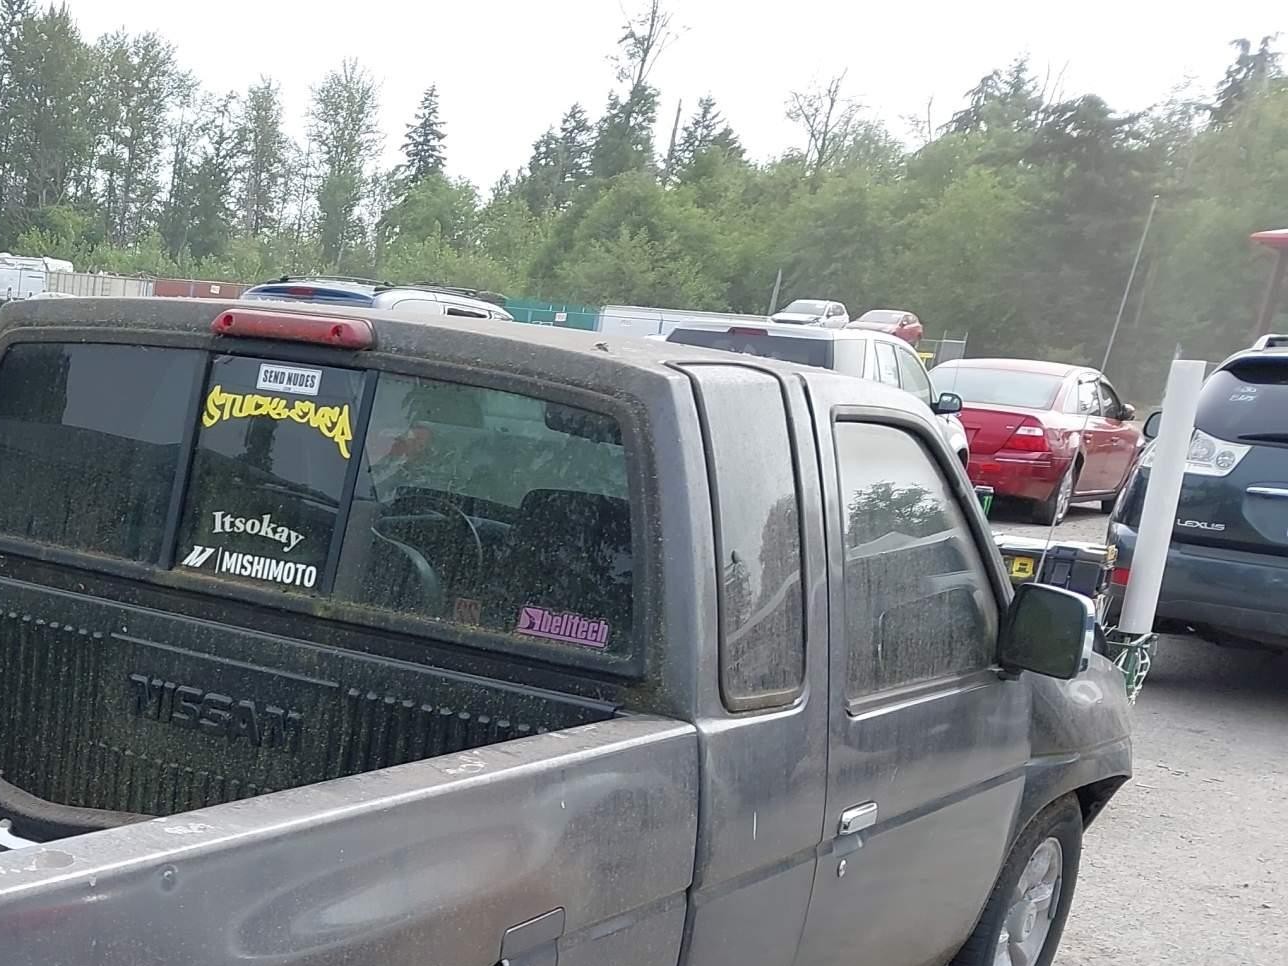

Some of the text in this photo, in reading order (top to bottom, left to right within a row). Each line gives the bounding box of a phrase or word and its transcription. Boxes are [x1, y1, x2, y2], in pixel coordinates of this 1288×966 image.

[262, 369, 317, 389] SEND NUDES
[213, 510, 305, 552] Itsokay
[1177, 518, 1226, 531] LEXUS
[221, 550, 317, 588] MISHIMOTO
[539, 610, 609, 643] belltech
